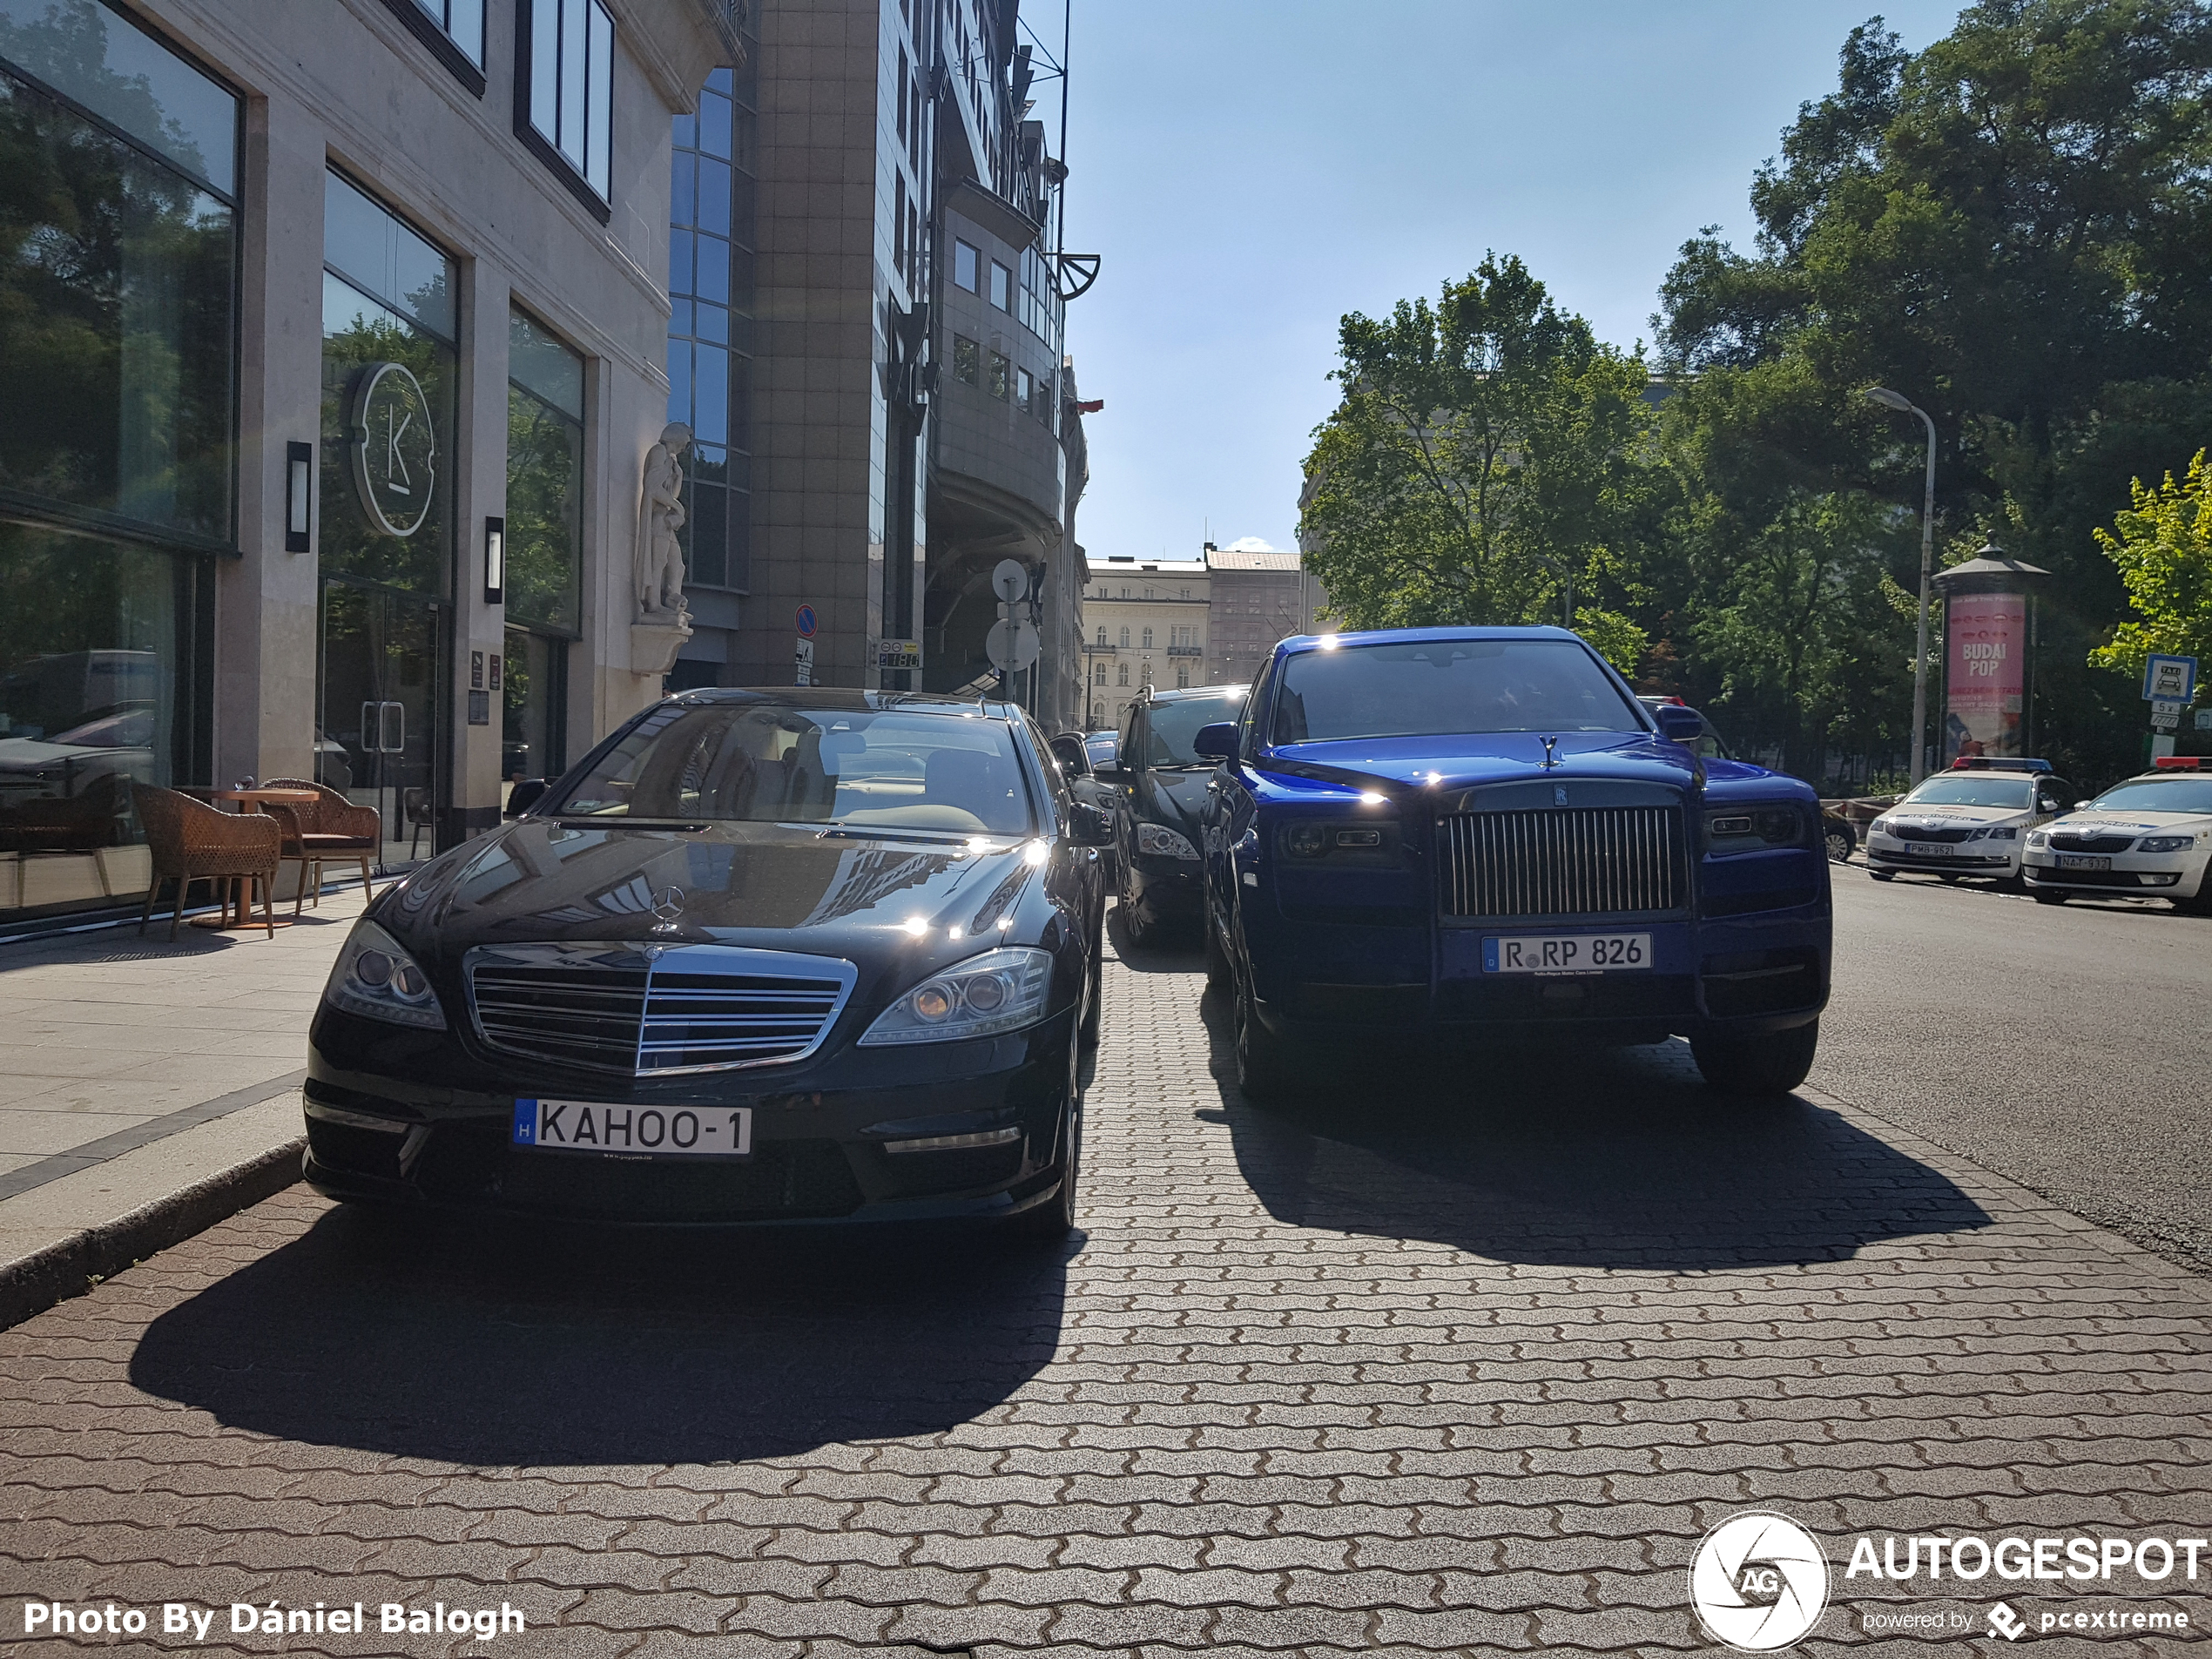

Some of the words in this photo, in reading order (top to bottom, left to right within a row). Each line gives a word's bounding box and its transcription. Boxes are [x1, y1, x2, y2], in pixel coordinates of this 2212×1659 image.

[388, 402, 412, 486] K
[1969, 660, 2000, 677] POP
[1506, 941, 1524, 968] R
[1542, 941, 1577, 967] RP
[1591, 938, 1642, 965] 826
[519, 1124, 529, 1137] H
